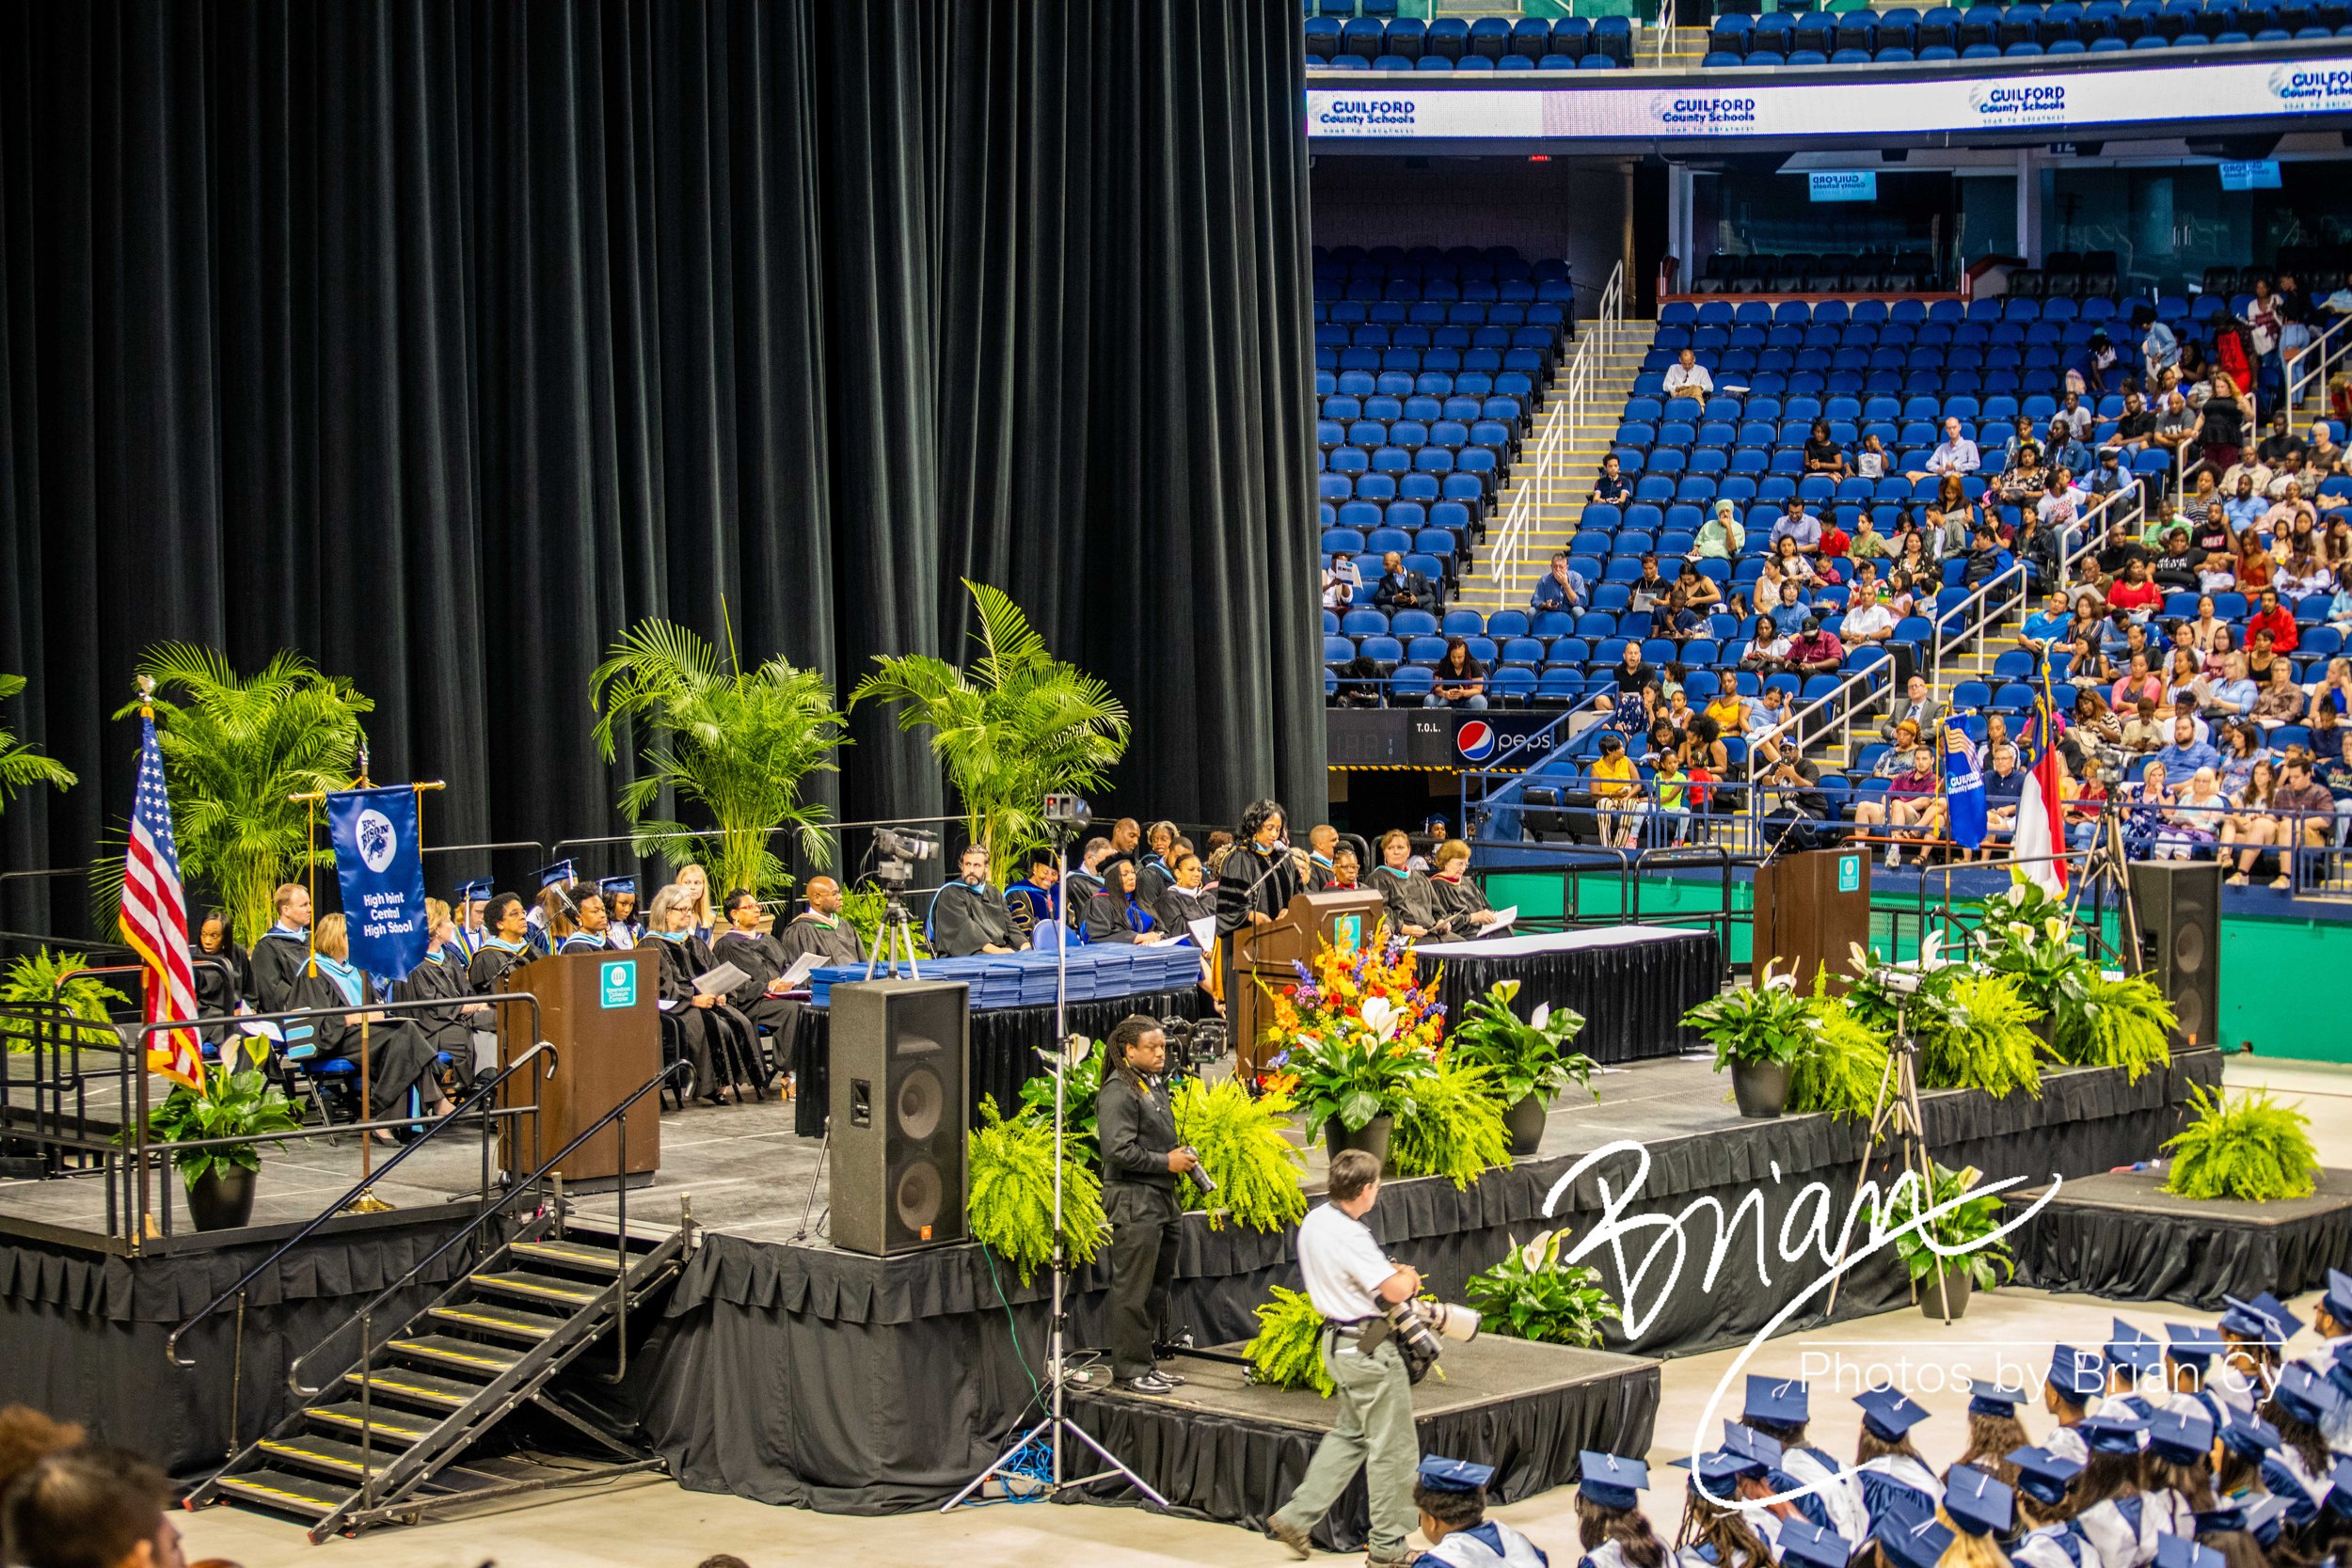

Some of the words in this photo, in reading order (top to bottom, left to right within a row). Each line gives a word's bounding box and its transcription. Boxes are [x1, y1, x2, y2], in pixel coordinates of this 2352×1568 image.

[2292, 71, 2352, 87] GUILFO
[1991, 86, 2065, 103] GUILFORD
[1332, 101, 1415, 114] GUILFORD
[1675, 98, 1756, 112] GUILFORD
[1979, 103, 2020, 114] County
[2022, 100, 2065, 111] Schools
[1320, 113, 1364, 125] County
[1367, 113, 1415, 123] Schools
[1662, 112, 1706, 123] County
[1709, 111, 1756, 122] Schools
[1416, 722, 1441, 733] T.O.L.
[1498, 734, 1558, 752] peps
[363, 893, 385, 909] High
[363, 923, 387, 939] High
[387, 919, 414, 934] Shool
